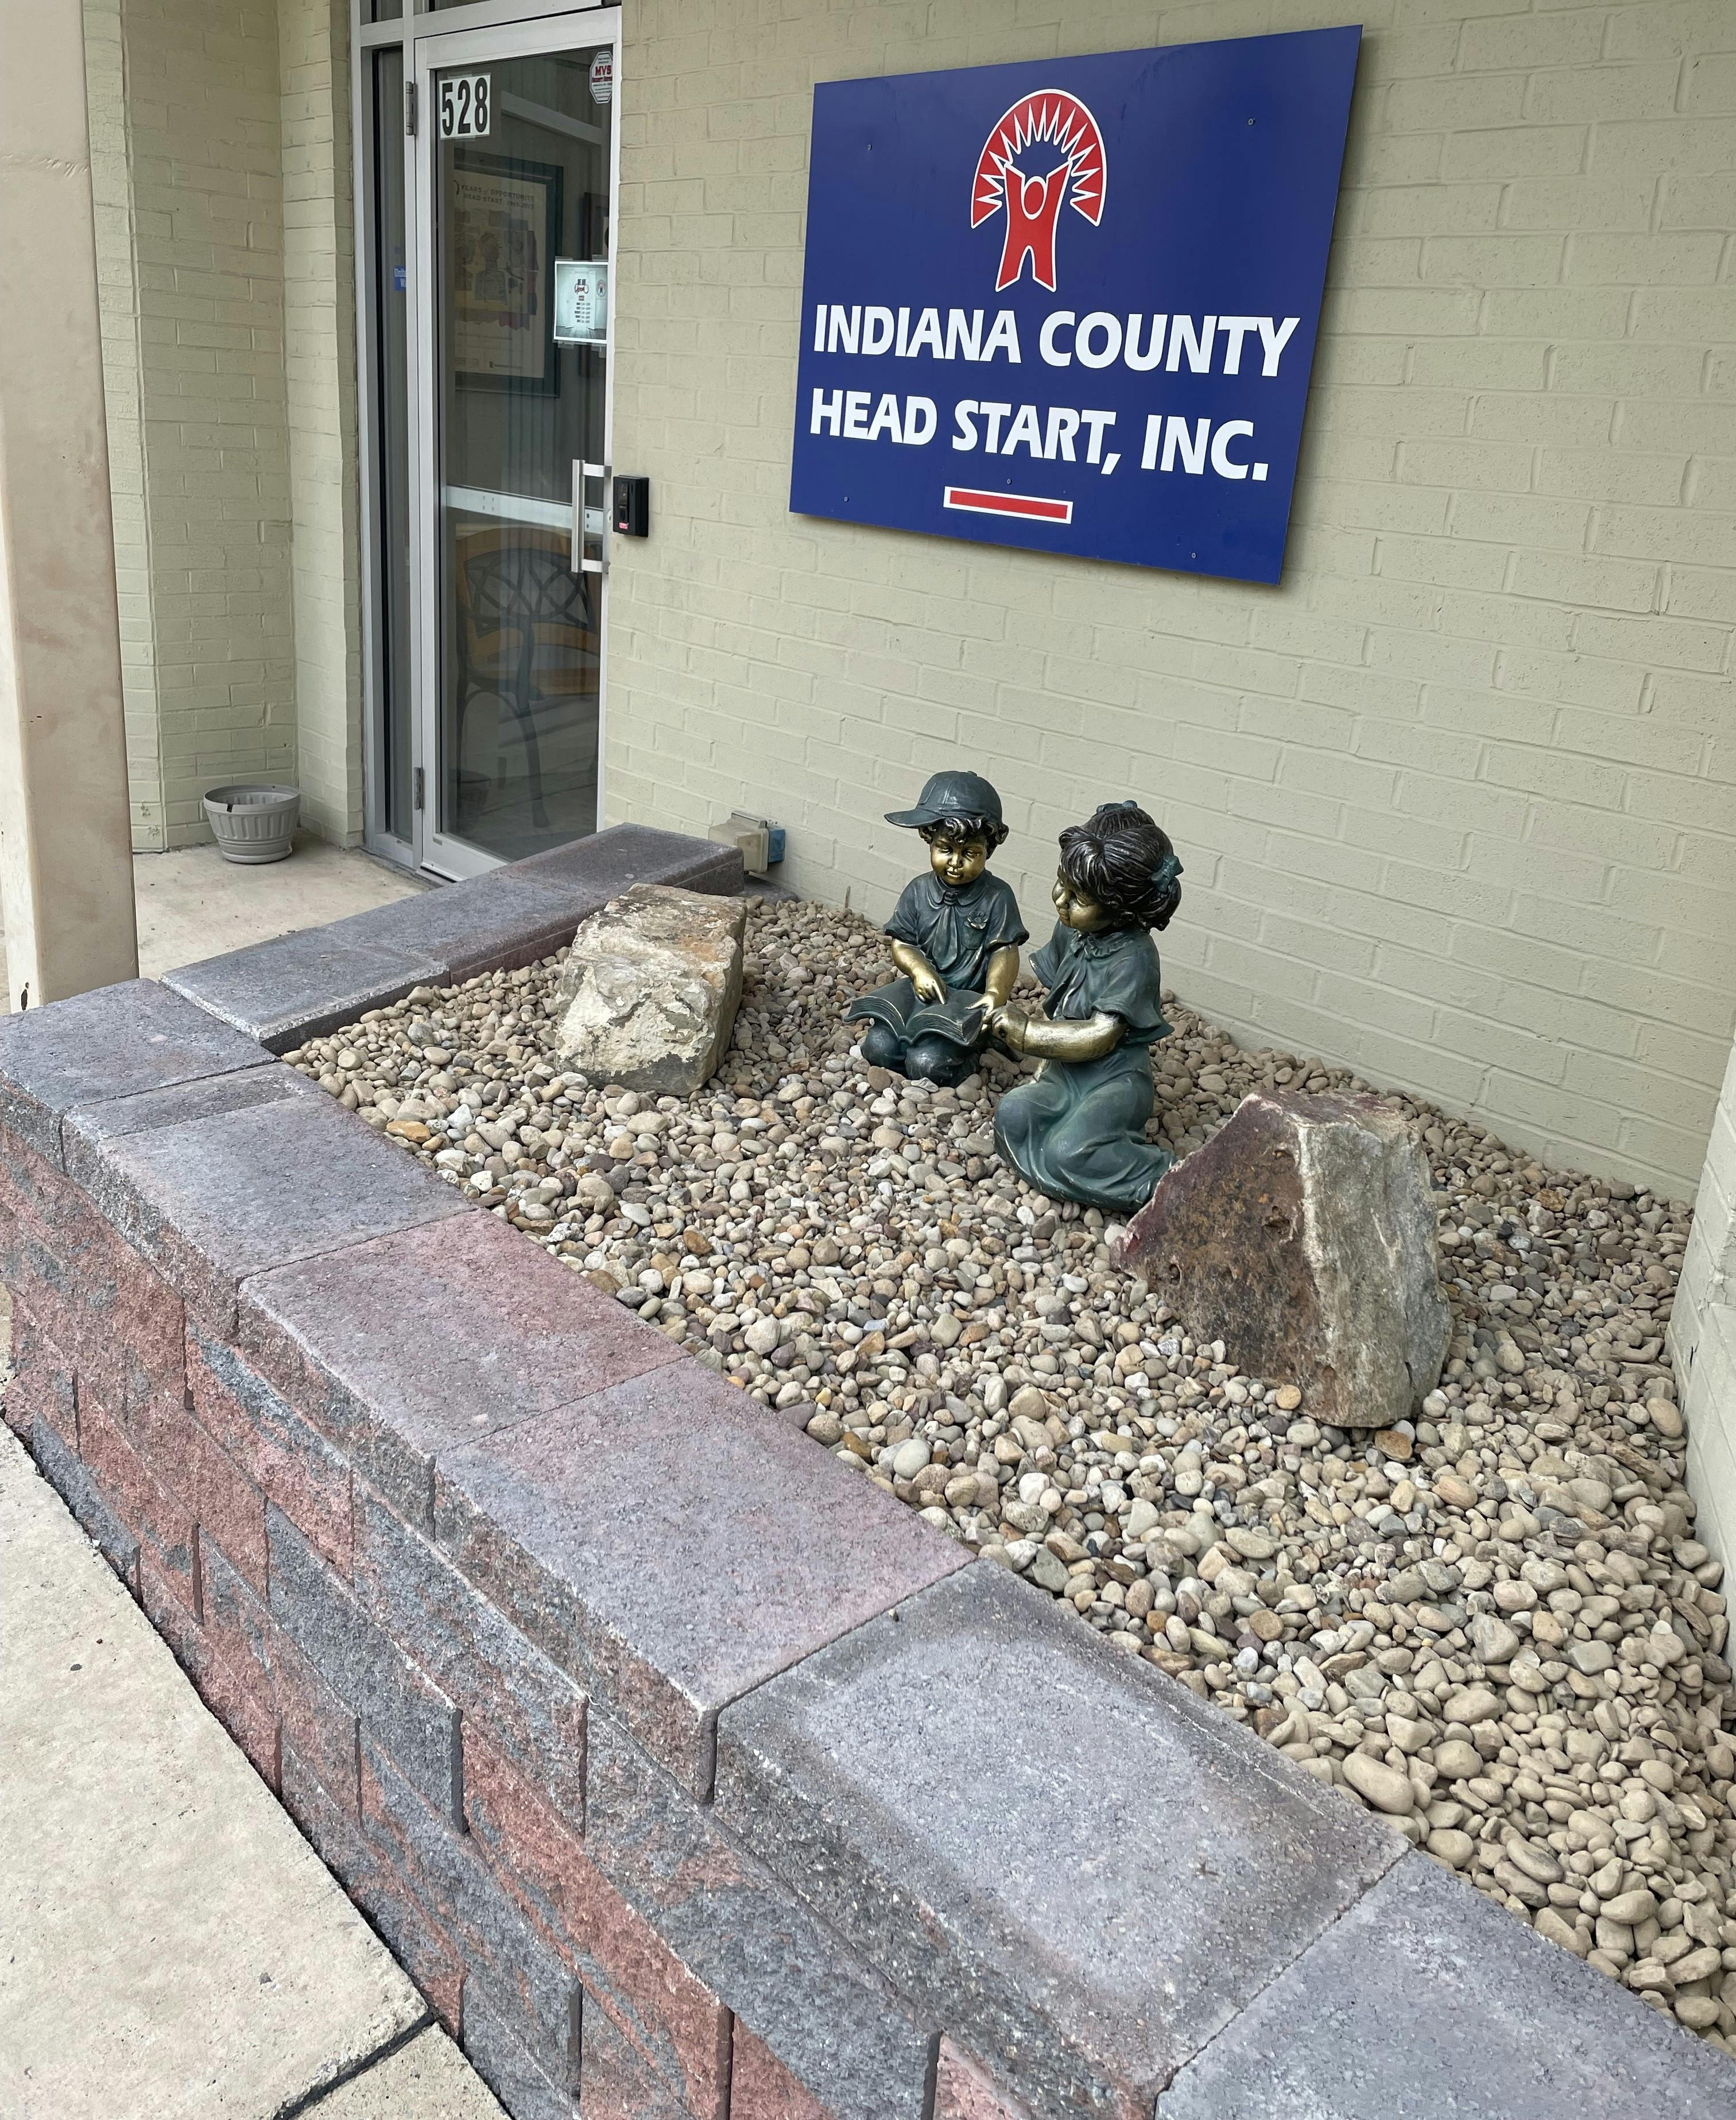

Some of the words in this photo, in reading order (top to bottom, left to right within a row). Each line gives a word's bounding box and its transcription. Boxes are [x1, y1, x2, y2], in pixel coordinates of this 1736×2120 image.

[442, 78, 487, 136] 528
[813, 304, 1021, 363] INDIANA
[1040, 311, 1300, 377] COUNTY
[810, 388, 937, 445] HEAD
[952, 400, 1121, 475] START,
[1141, 415, 1269, 481] INC.
